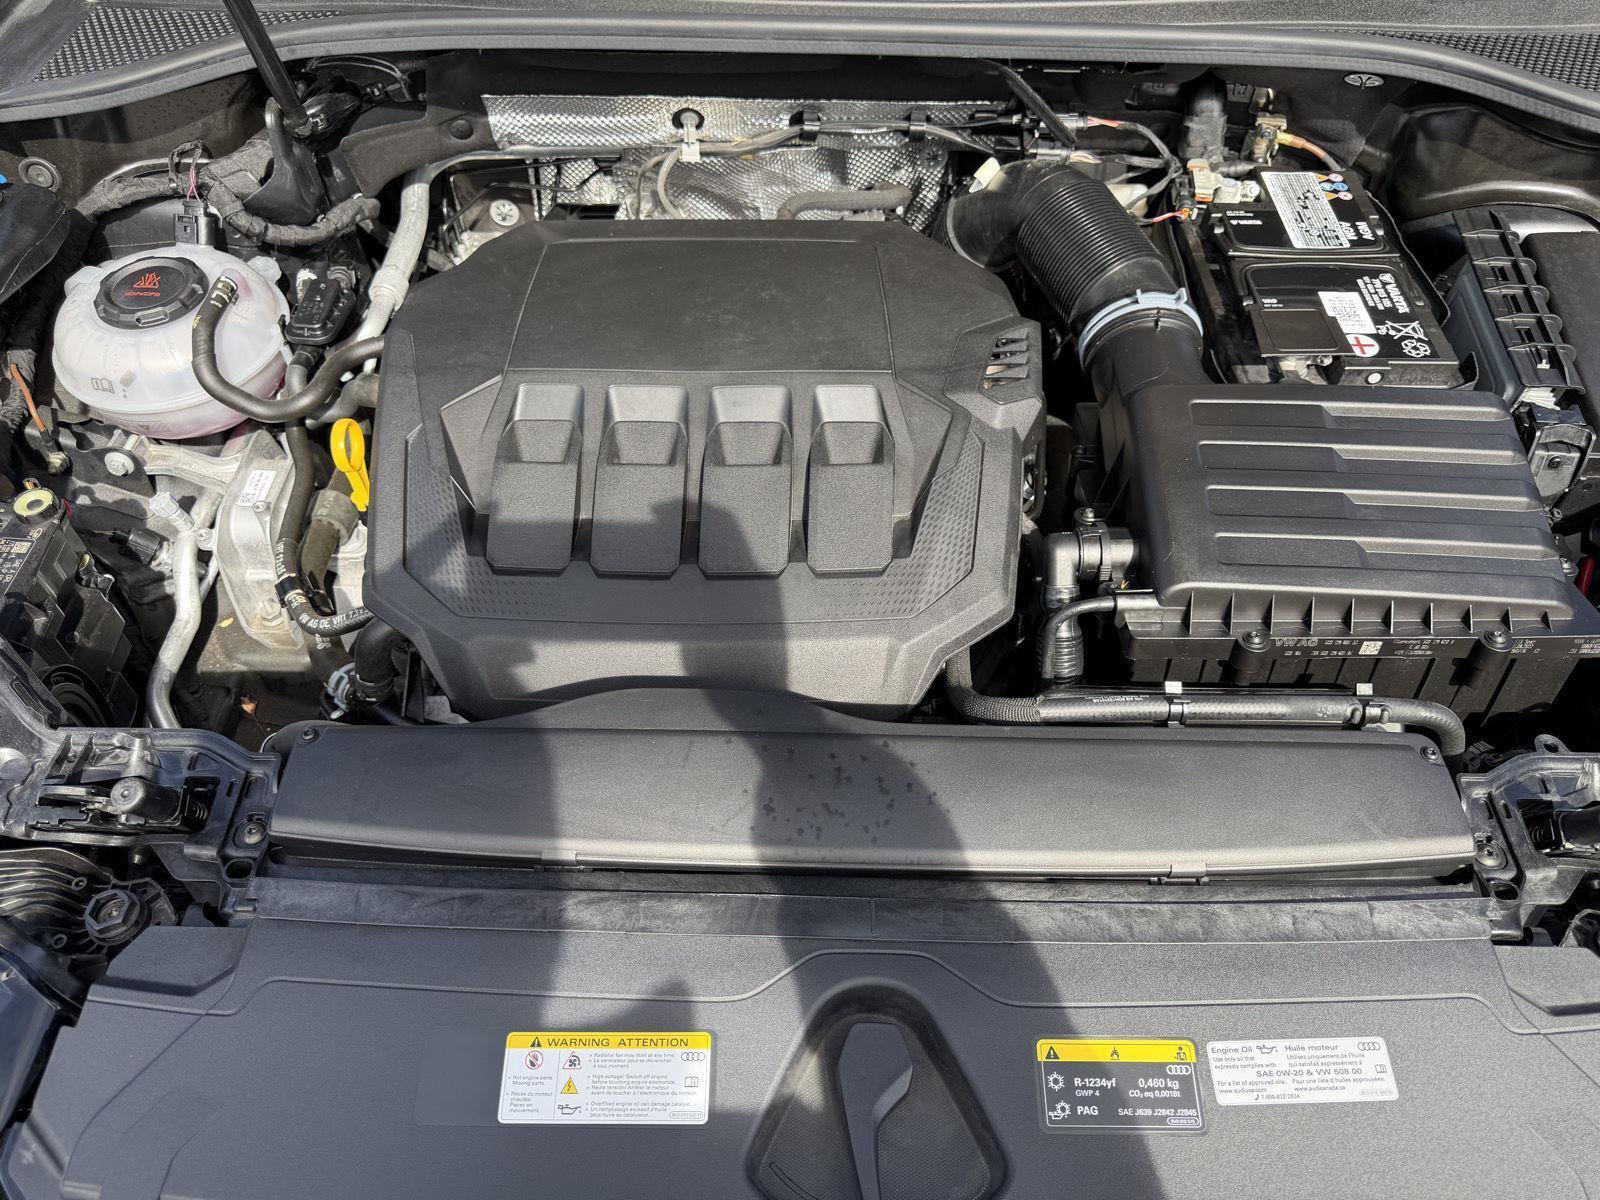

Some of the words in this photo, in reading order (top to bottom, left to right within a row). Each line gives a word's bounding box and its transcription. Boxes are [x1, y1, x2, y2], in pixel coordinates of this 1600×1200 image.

[1339, 221, 1358, 240] AGM
[1355, 221, 1376, 241] AGM
[1385, 283, 1410, 313] VARTA
[308, 619, 318, 629] AG
[319, 619, 331, 629] DE
[1274, 638, 1296, 647] VW
[1297, 638, 1319, 647] AG
[547, 1038, 610, 1047] WARNING
[617, 1038, 689, 1047] ATTENTION
[1211, 1047, 1239, 1055] Engine
[1241, 1045, 1253, 1053] Oil
[1276, 1069, 1304, 1077] 0W-20
[1351, 1067, 1363, 1075] 00
[1074, 1077, 1116, 1089] R-1234yf
[1138, 1078, 1165, 1088] 0,460
[1167, 1078, 1179, 1089] kg
[1075, 1089, 1093, 1097] GWP
[1094, 1089, 1100, 1097] 4
[1077, 1105, 1099, 1116] PAG
[1118, 1108, 1134, 1116] SAE
[1134, 1108, 1152, 1116] J639
[1153, 1108, 1175, 1116] J2842
